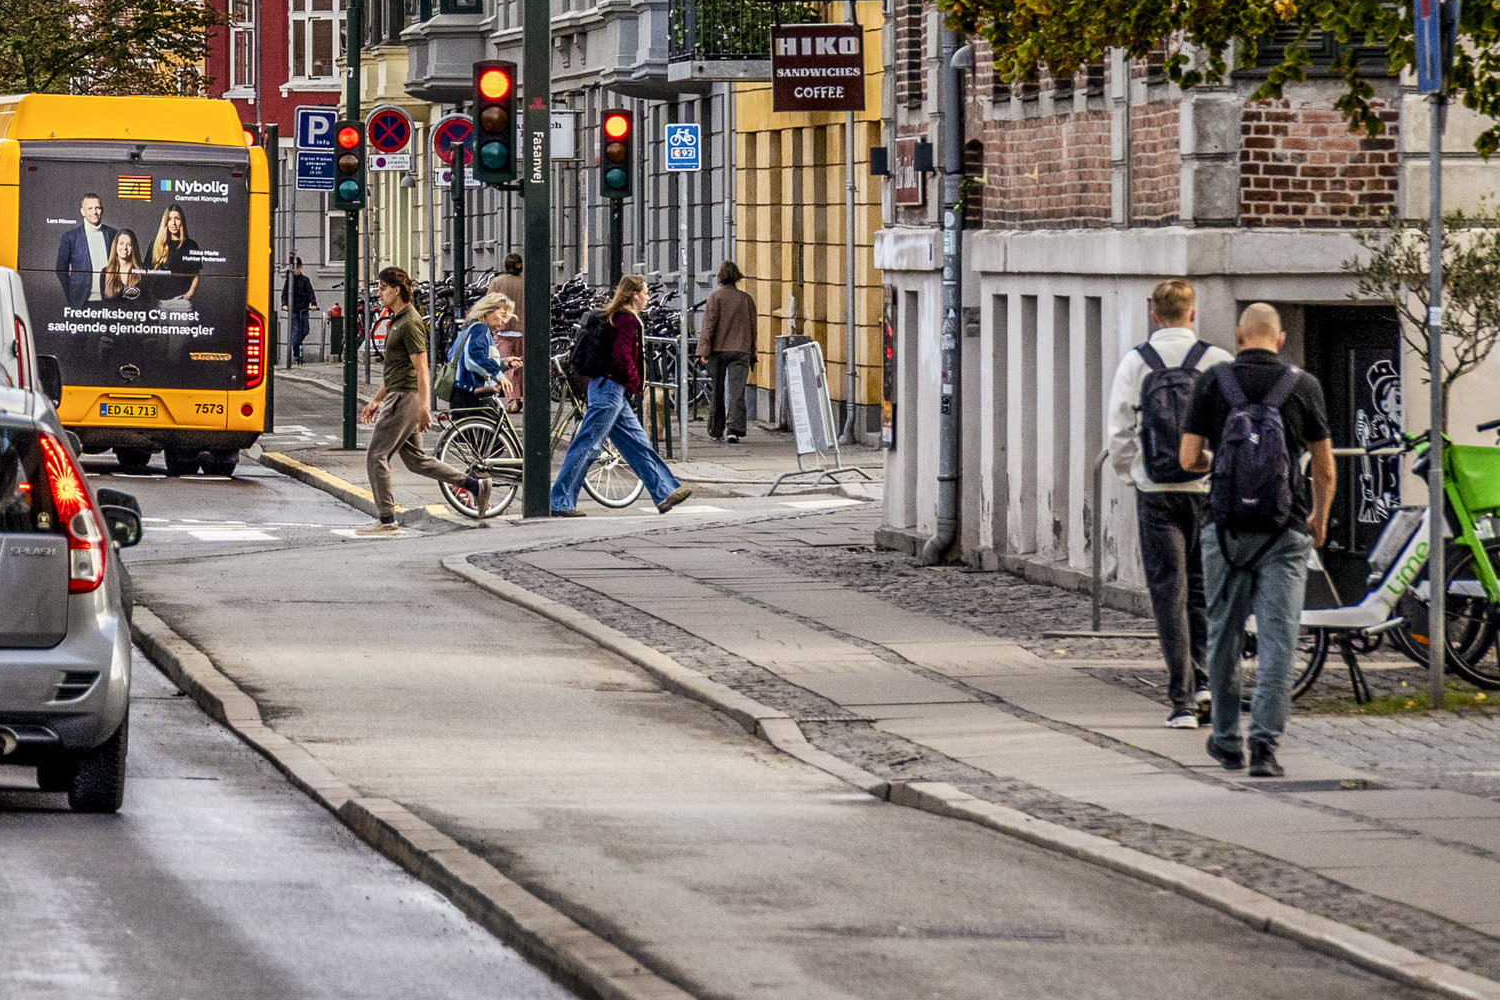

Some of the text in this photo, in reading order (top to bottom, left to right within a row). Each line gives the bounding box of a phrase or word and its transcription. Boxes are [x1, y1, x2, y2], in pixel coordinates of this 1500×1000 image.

[775, 36, 859, 55] HIKO
[776, 67, 860, 77] SANDWICHES
[793, 86, 844, 98] COFFEE
[307, 115, 329, 145] P
[530, 131, 544, 183] Fasanvej
[175, 180, 228, 196] Nybolig
[63, 307, 199, 322] Frederiksberg C's mest
[47, 322, 215, 337] sælgende ejendomsmægler
[107, 405, 156, 416] ED 41 713
[195, 404, 224, 414] 7573
